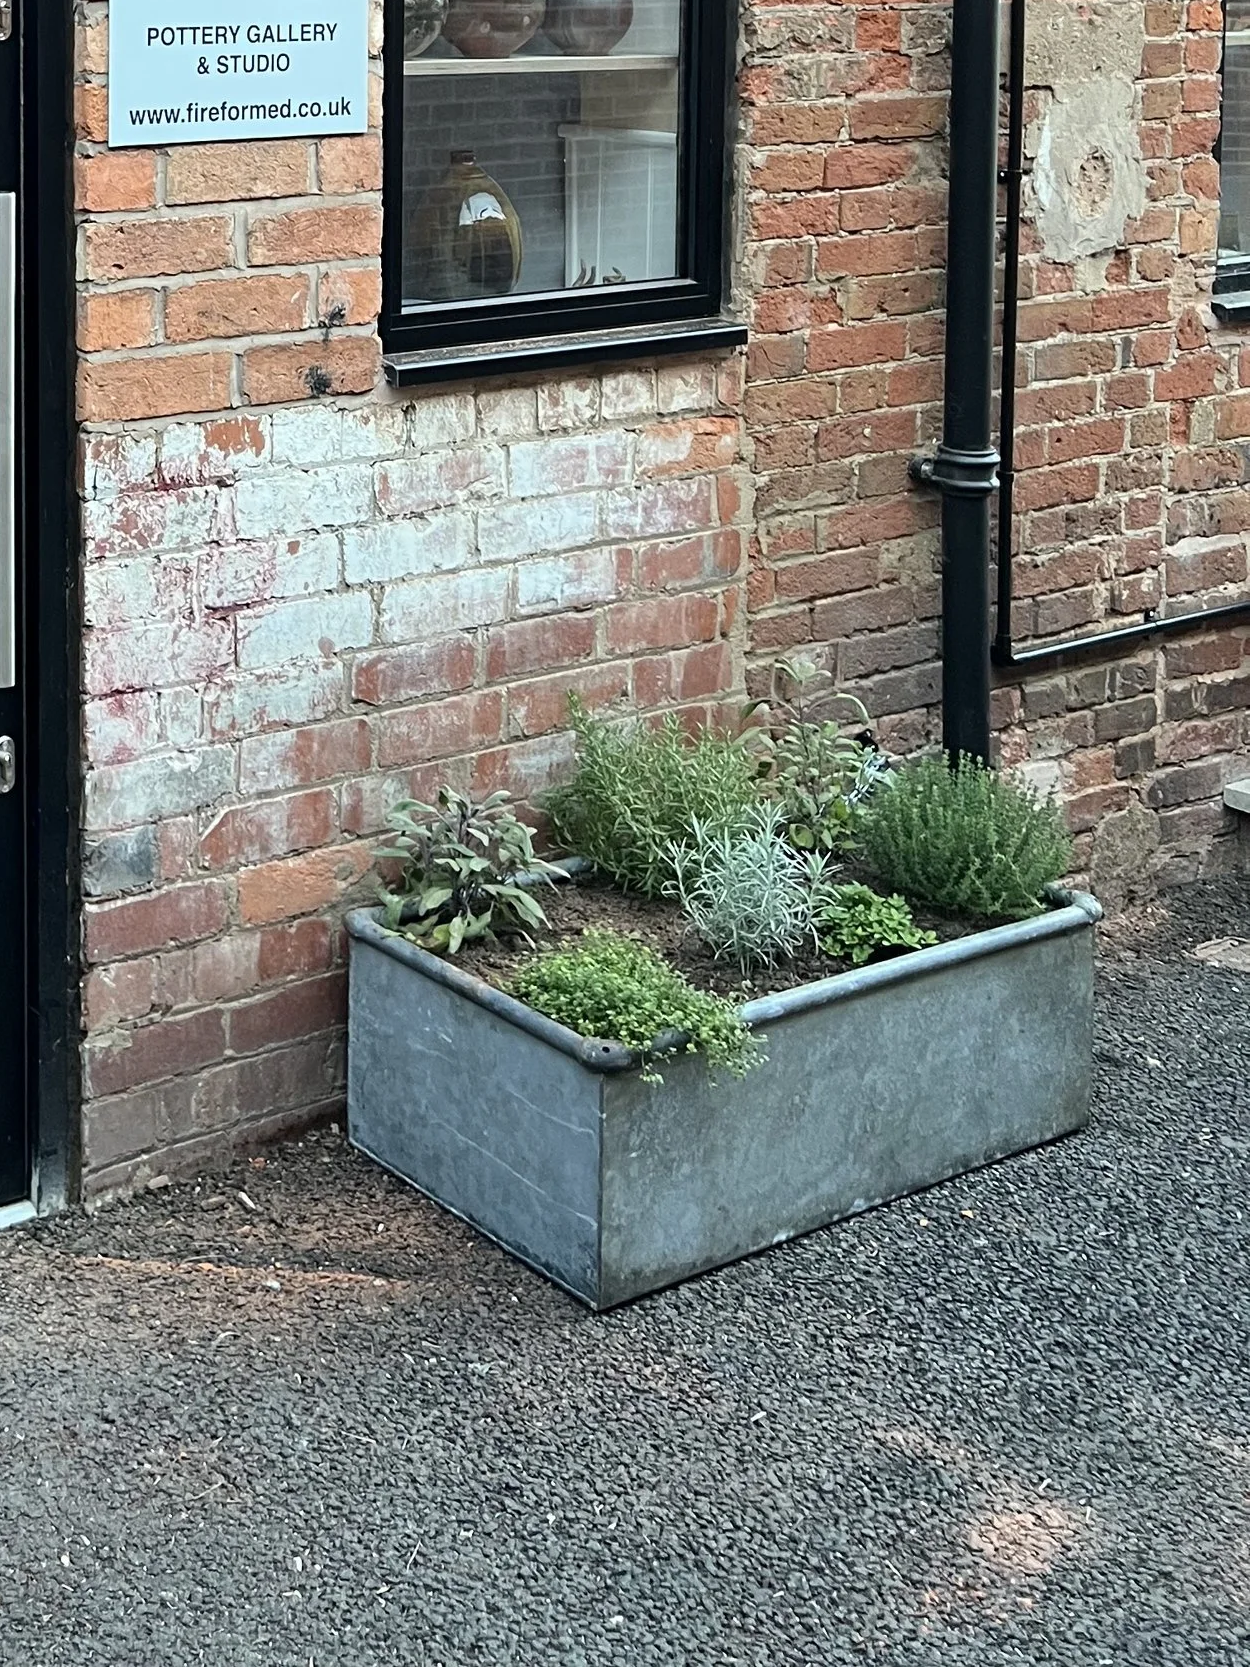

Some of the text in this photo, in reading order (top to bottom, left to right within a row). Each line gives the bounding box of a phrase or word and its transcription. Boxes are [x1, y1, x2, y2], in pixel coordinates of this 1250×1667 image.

[147, 22, 339, 47] POTTERY GALLERY
[196, 52, 291, 75] & STUDIO
[129, 97, 352, 126] www.fireformed.co.uk
